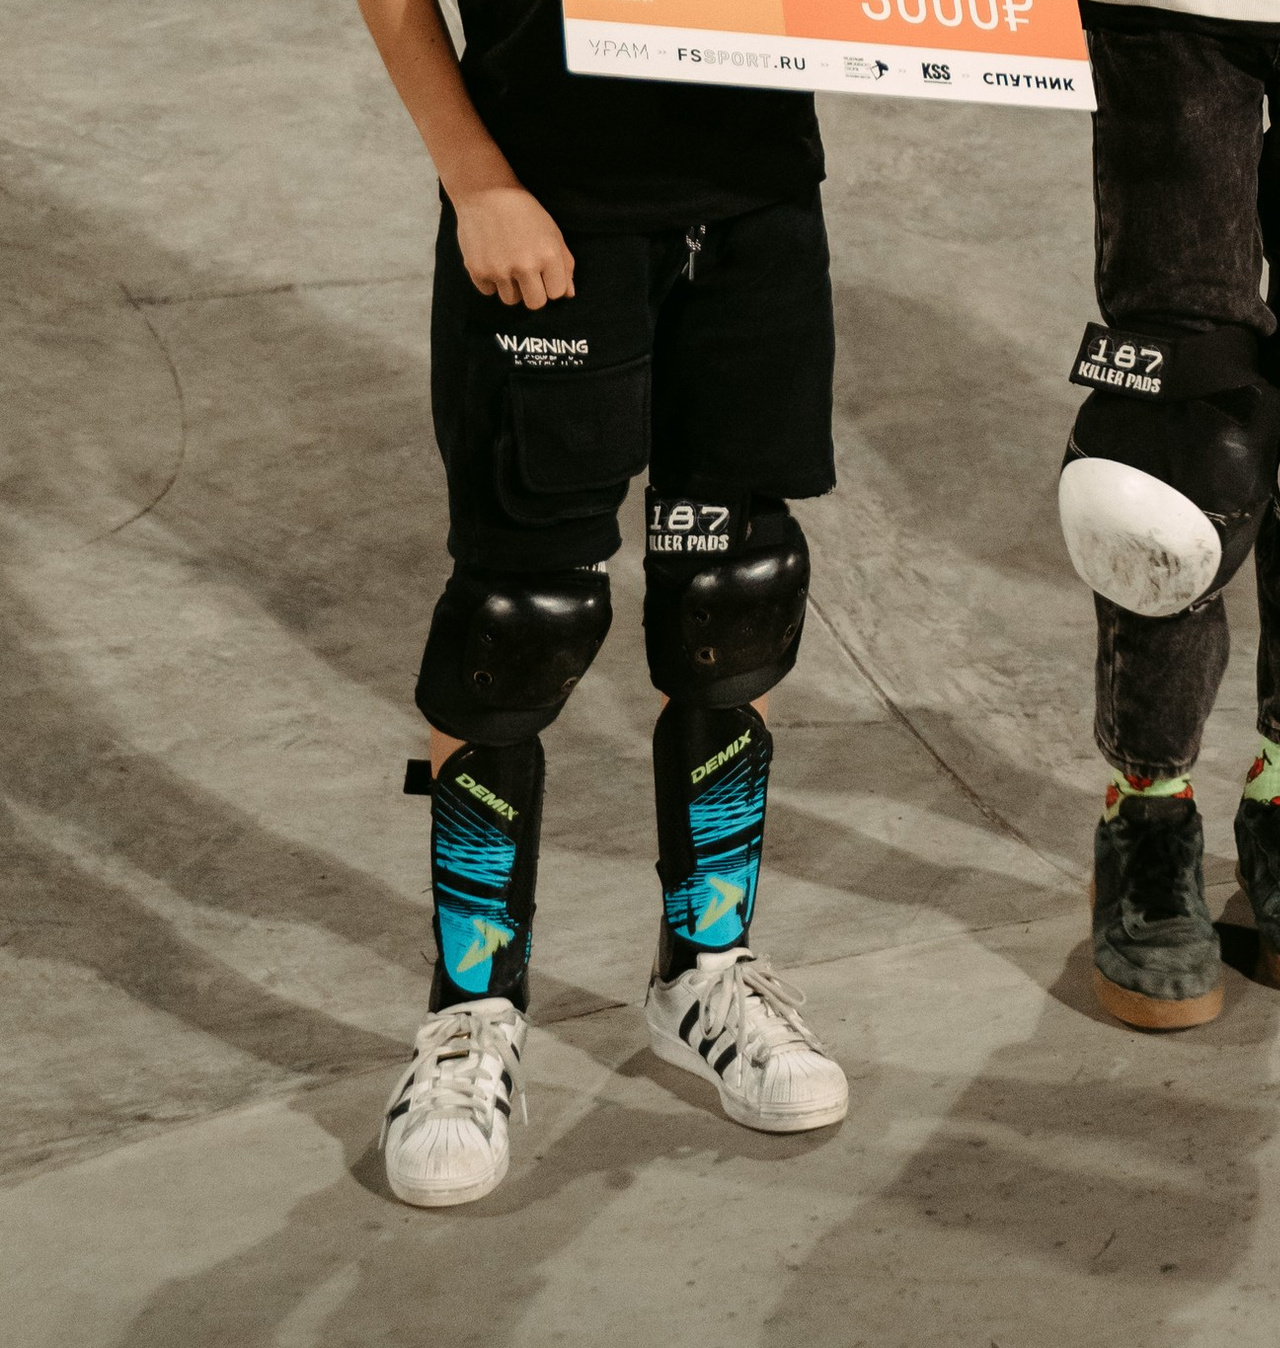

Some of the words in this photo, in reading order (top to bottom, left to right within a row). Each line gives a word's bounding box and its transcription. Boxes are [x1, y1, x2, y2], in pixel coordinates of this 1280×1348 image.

[677, 47, 807, 71] FSSPORT.RU
[921, 61, 951, 81] KSS
[982, 72, 1076, 92] СПУТНИК
[496, 333, 589, 354] WARNING
[1091, 338, 1163, 374] 187
[1078, 360, 1125, 387] KILLER
[1124, 372, 1162, 394] PADS
[649, 505, 730, 532] 187
[686, 534, 730, 551] PADS
[691, 729, 753, 785] DEMIX
[455, 772, 519, 821] DEMIX
